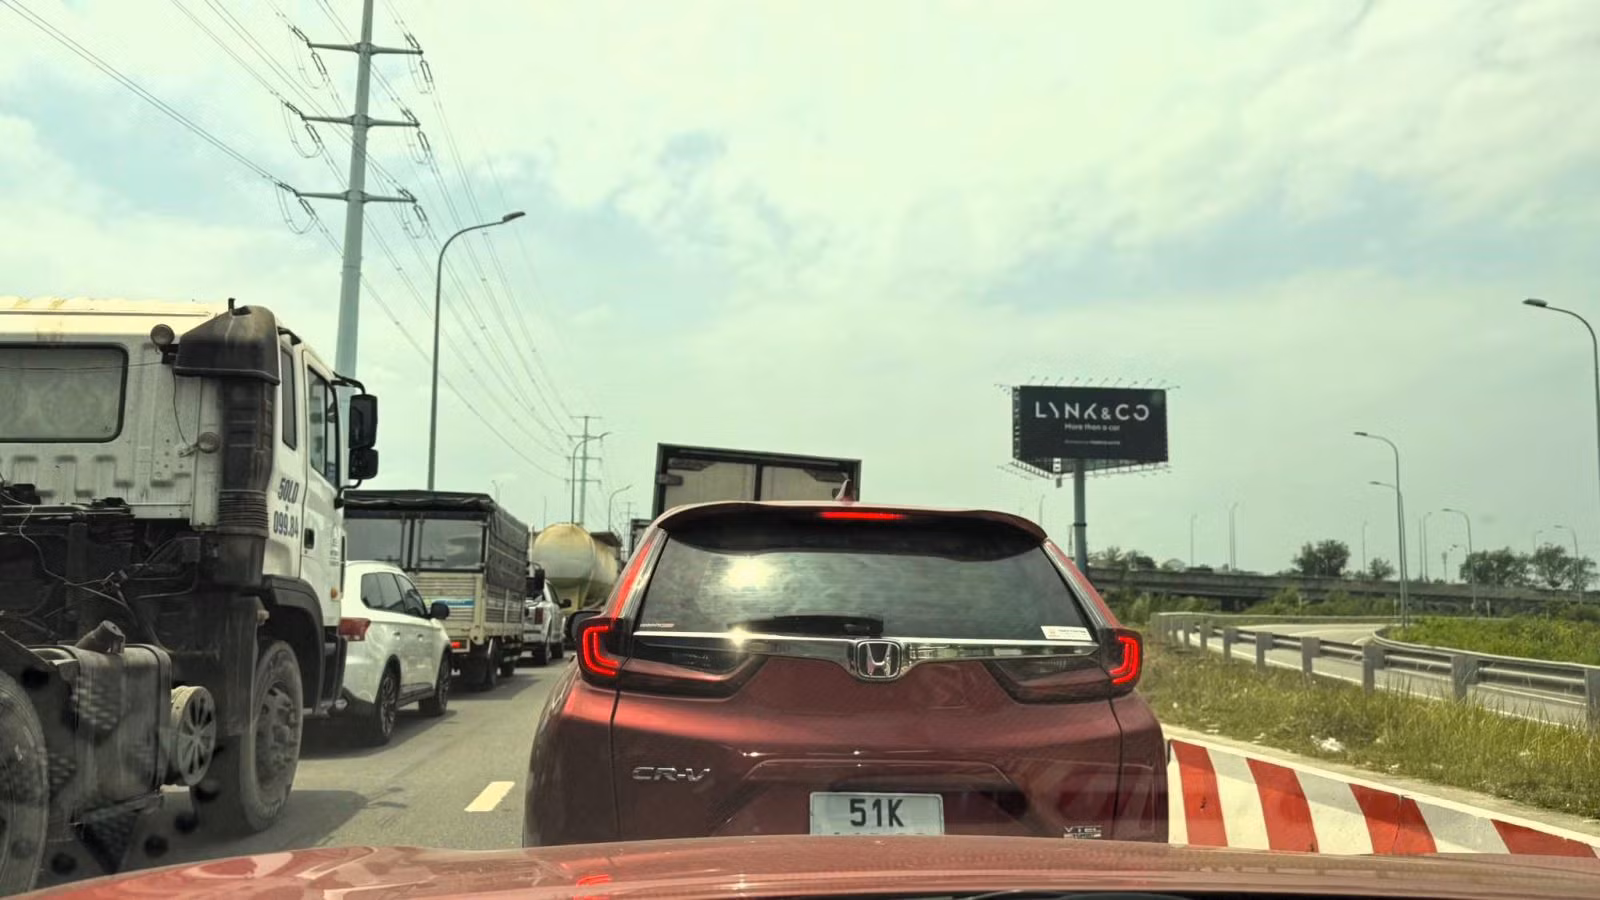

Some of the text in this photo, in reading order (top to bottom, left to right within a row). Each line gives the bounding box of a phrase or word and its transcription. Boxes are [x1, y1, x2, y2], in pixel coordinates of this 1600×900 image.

[1064, 423, 1083, 431] More
[1084, 423, 1101, 431] than
[632, 766, 710, 781] CR-V
[849, 798, 904, 828] 51K
